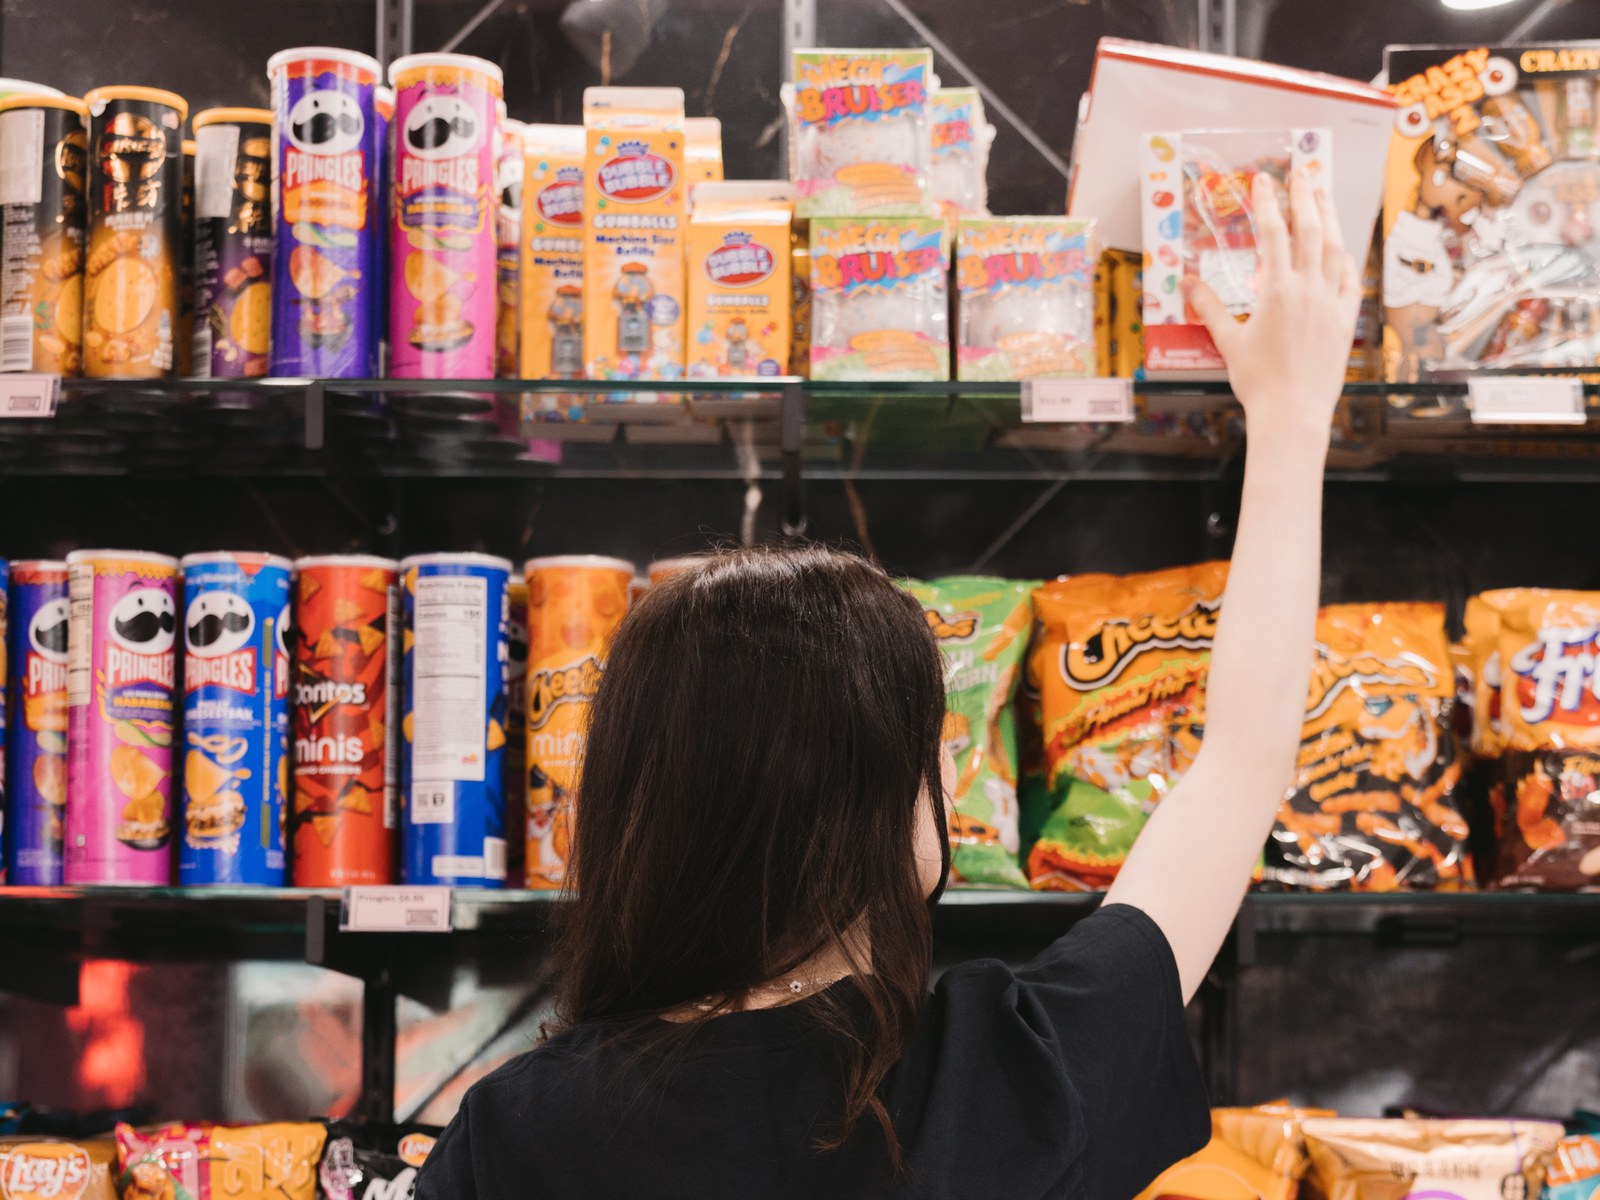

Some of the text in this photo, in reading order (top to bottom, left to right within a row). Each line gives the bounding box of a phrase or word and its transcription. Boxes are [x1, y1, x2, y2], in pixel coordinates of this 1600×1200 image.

[806, 58, 882, 86] MEGA
[800, 80, 926, 122] BRUISER
[287, 150, 362, 193] PRINGLES
[402, 156, 478, 196] PRINGLES
[593, 214, 677, 229] GUMBALLS
[822, 226, 901, 250] MEGA
[814, 248, 942, 289] BRUISER
[959, 249, 1088, 291] BRUISER
[9, 1153, 85, 1197] Lay's
